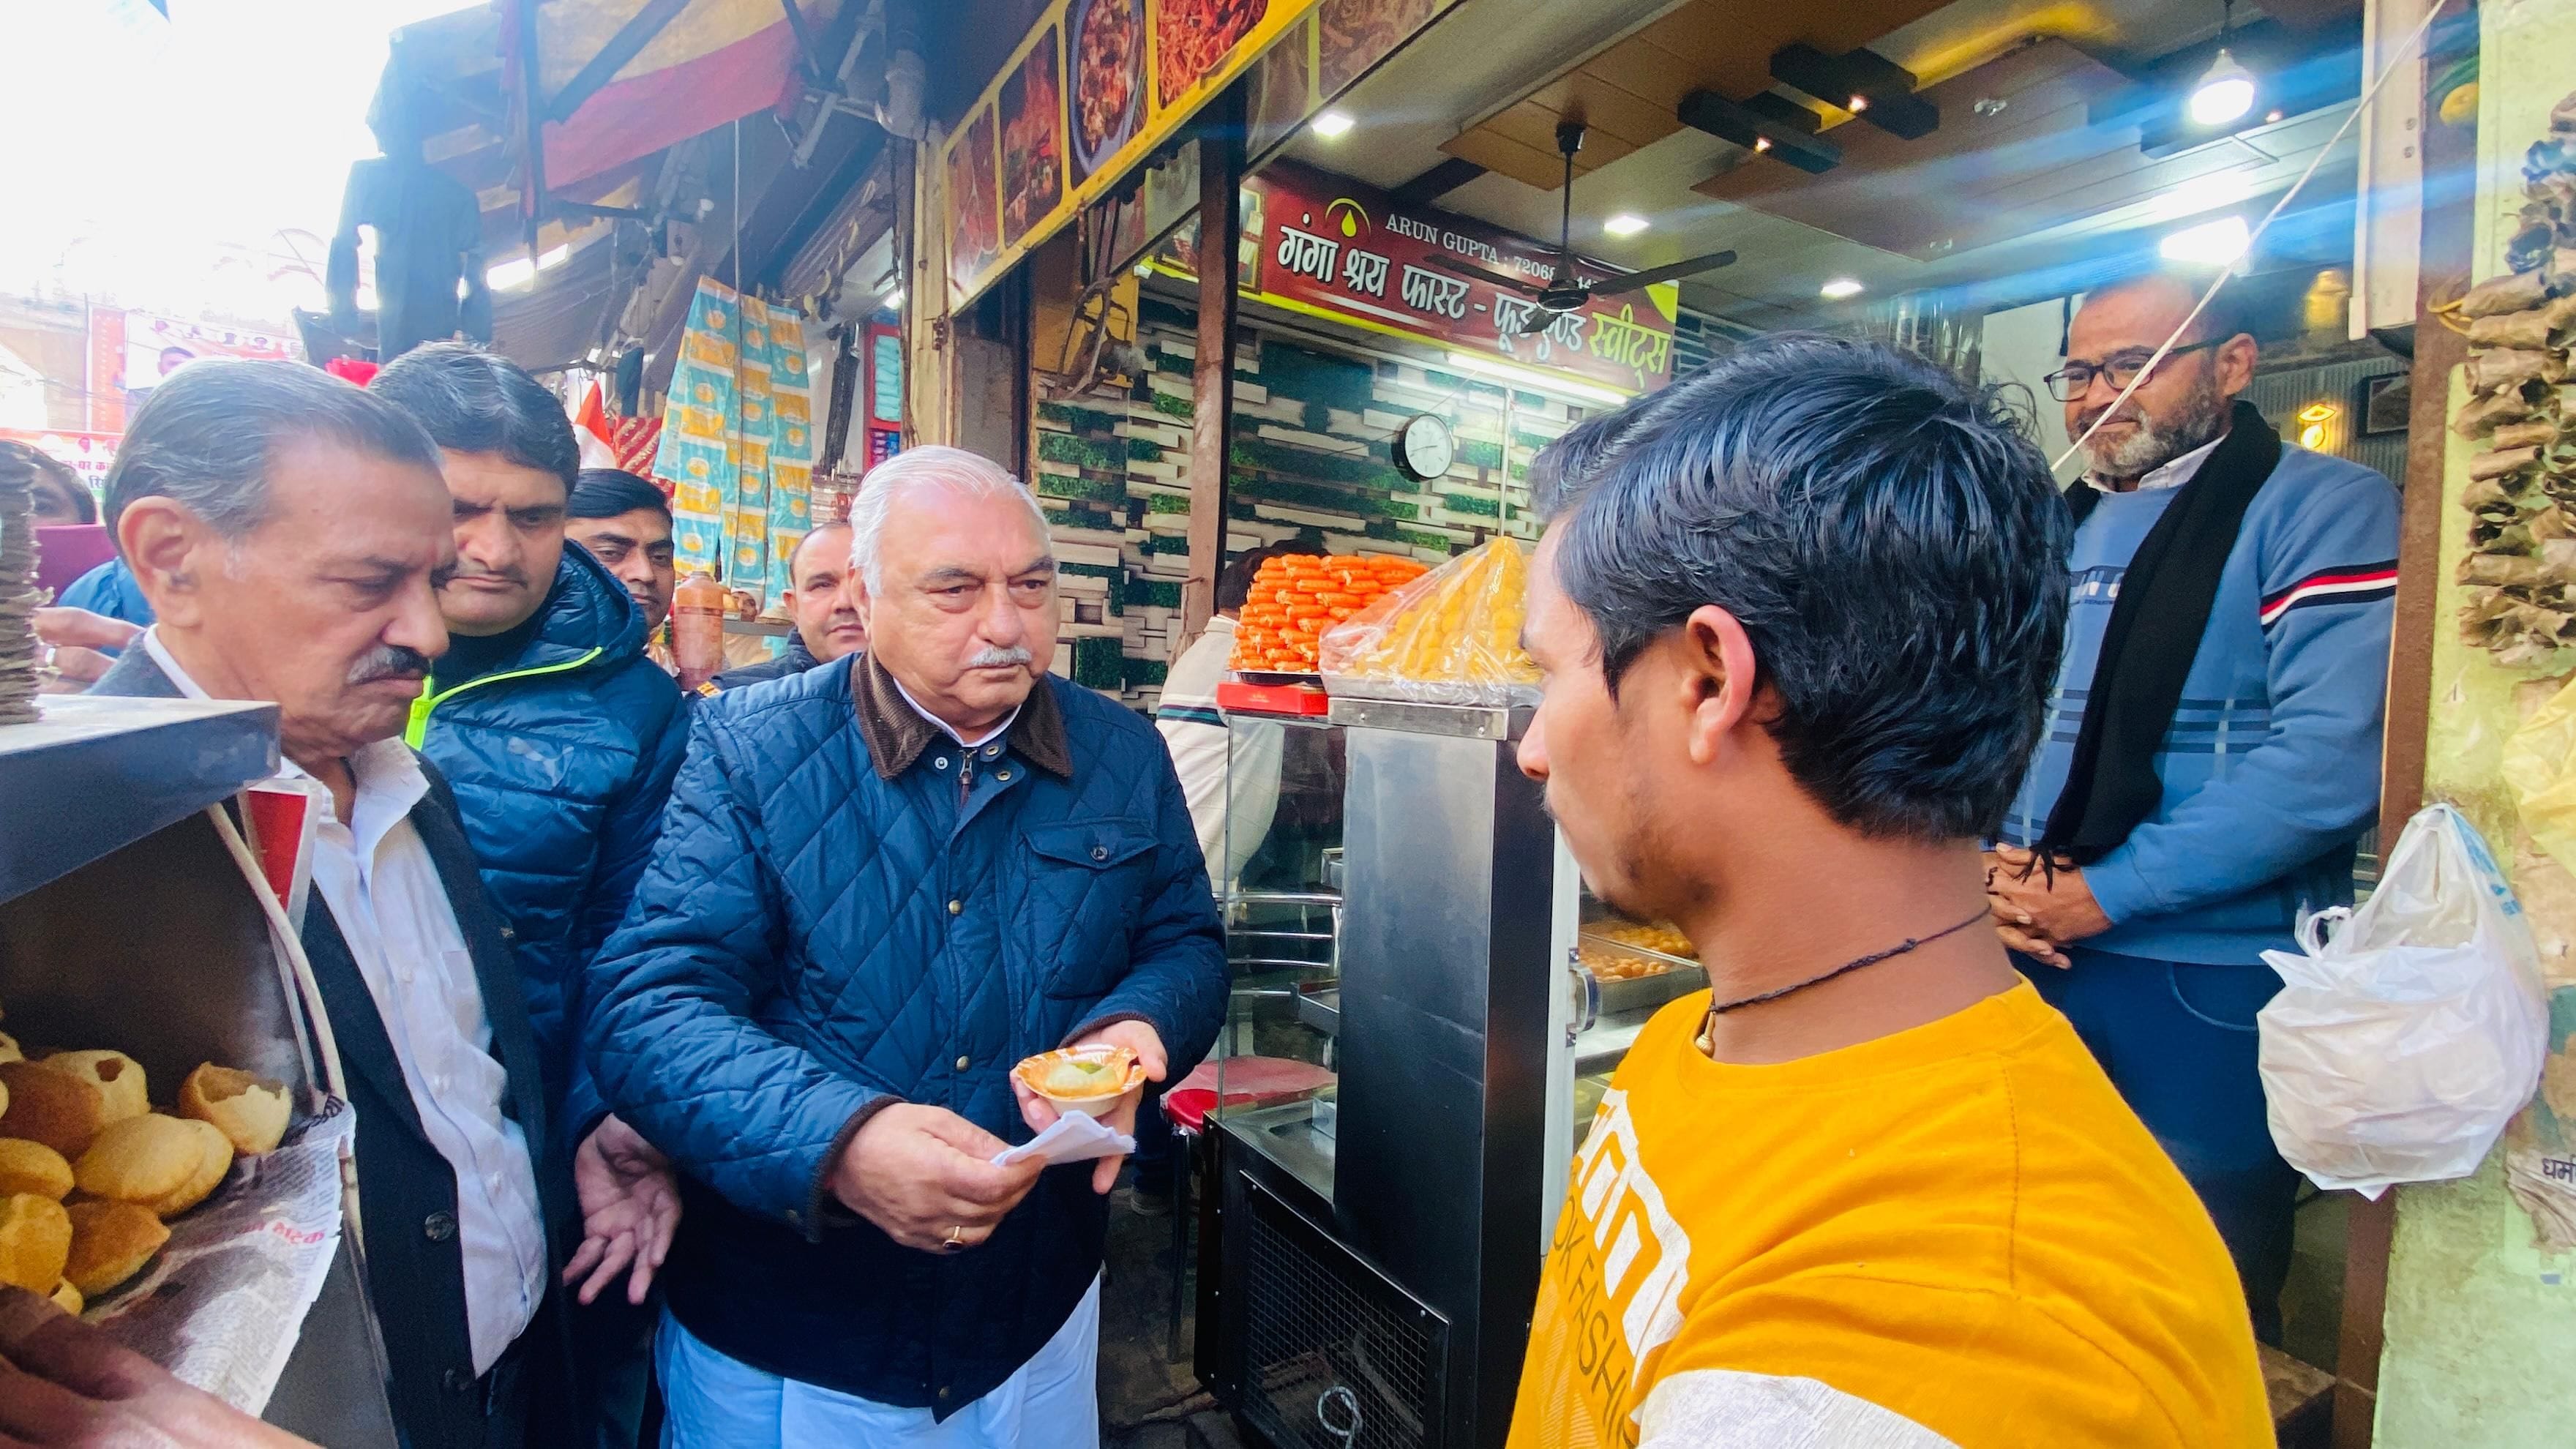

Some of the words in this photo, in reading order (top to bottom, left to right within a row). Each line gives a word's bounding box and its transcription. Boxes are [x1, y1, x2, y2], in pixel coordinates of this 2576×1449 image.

[1385, 213, 1439, 245] ARUN
[1442, 231, 1500, 266] GUPTA
[1278, 212, 1339, 283] गंगा
[1401, 264, 1470, 319] फास्ट
[1589, 303, 1671, 389] स्वीट्स
